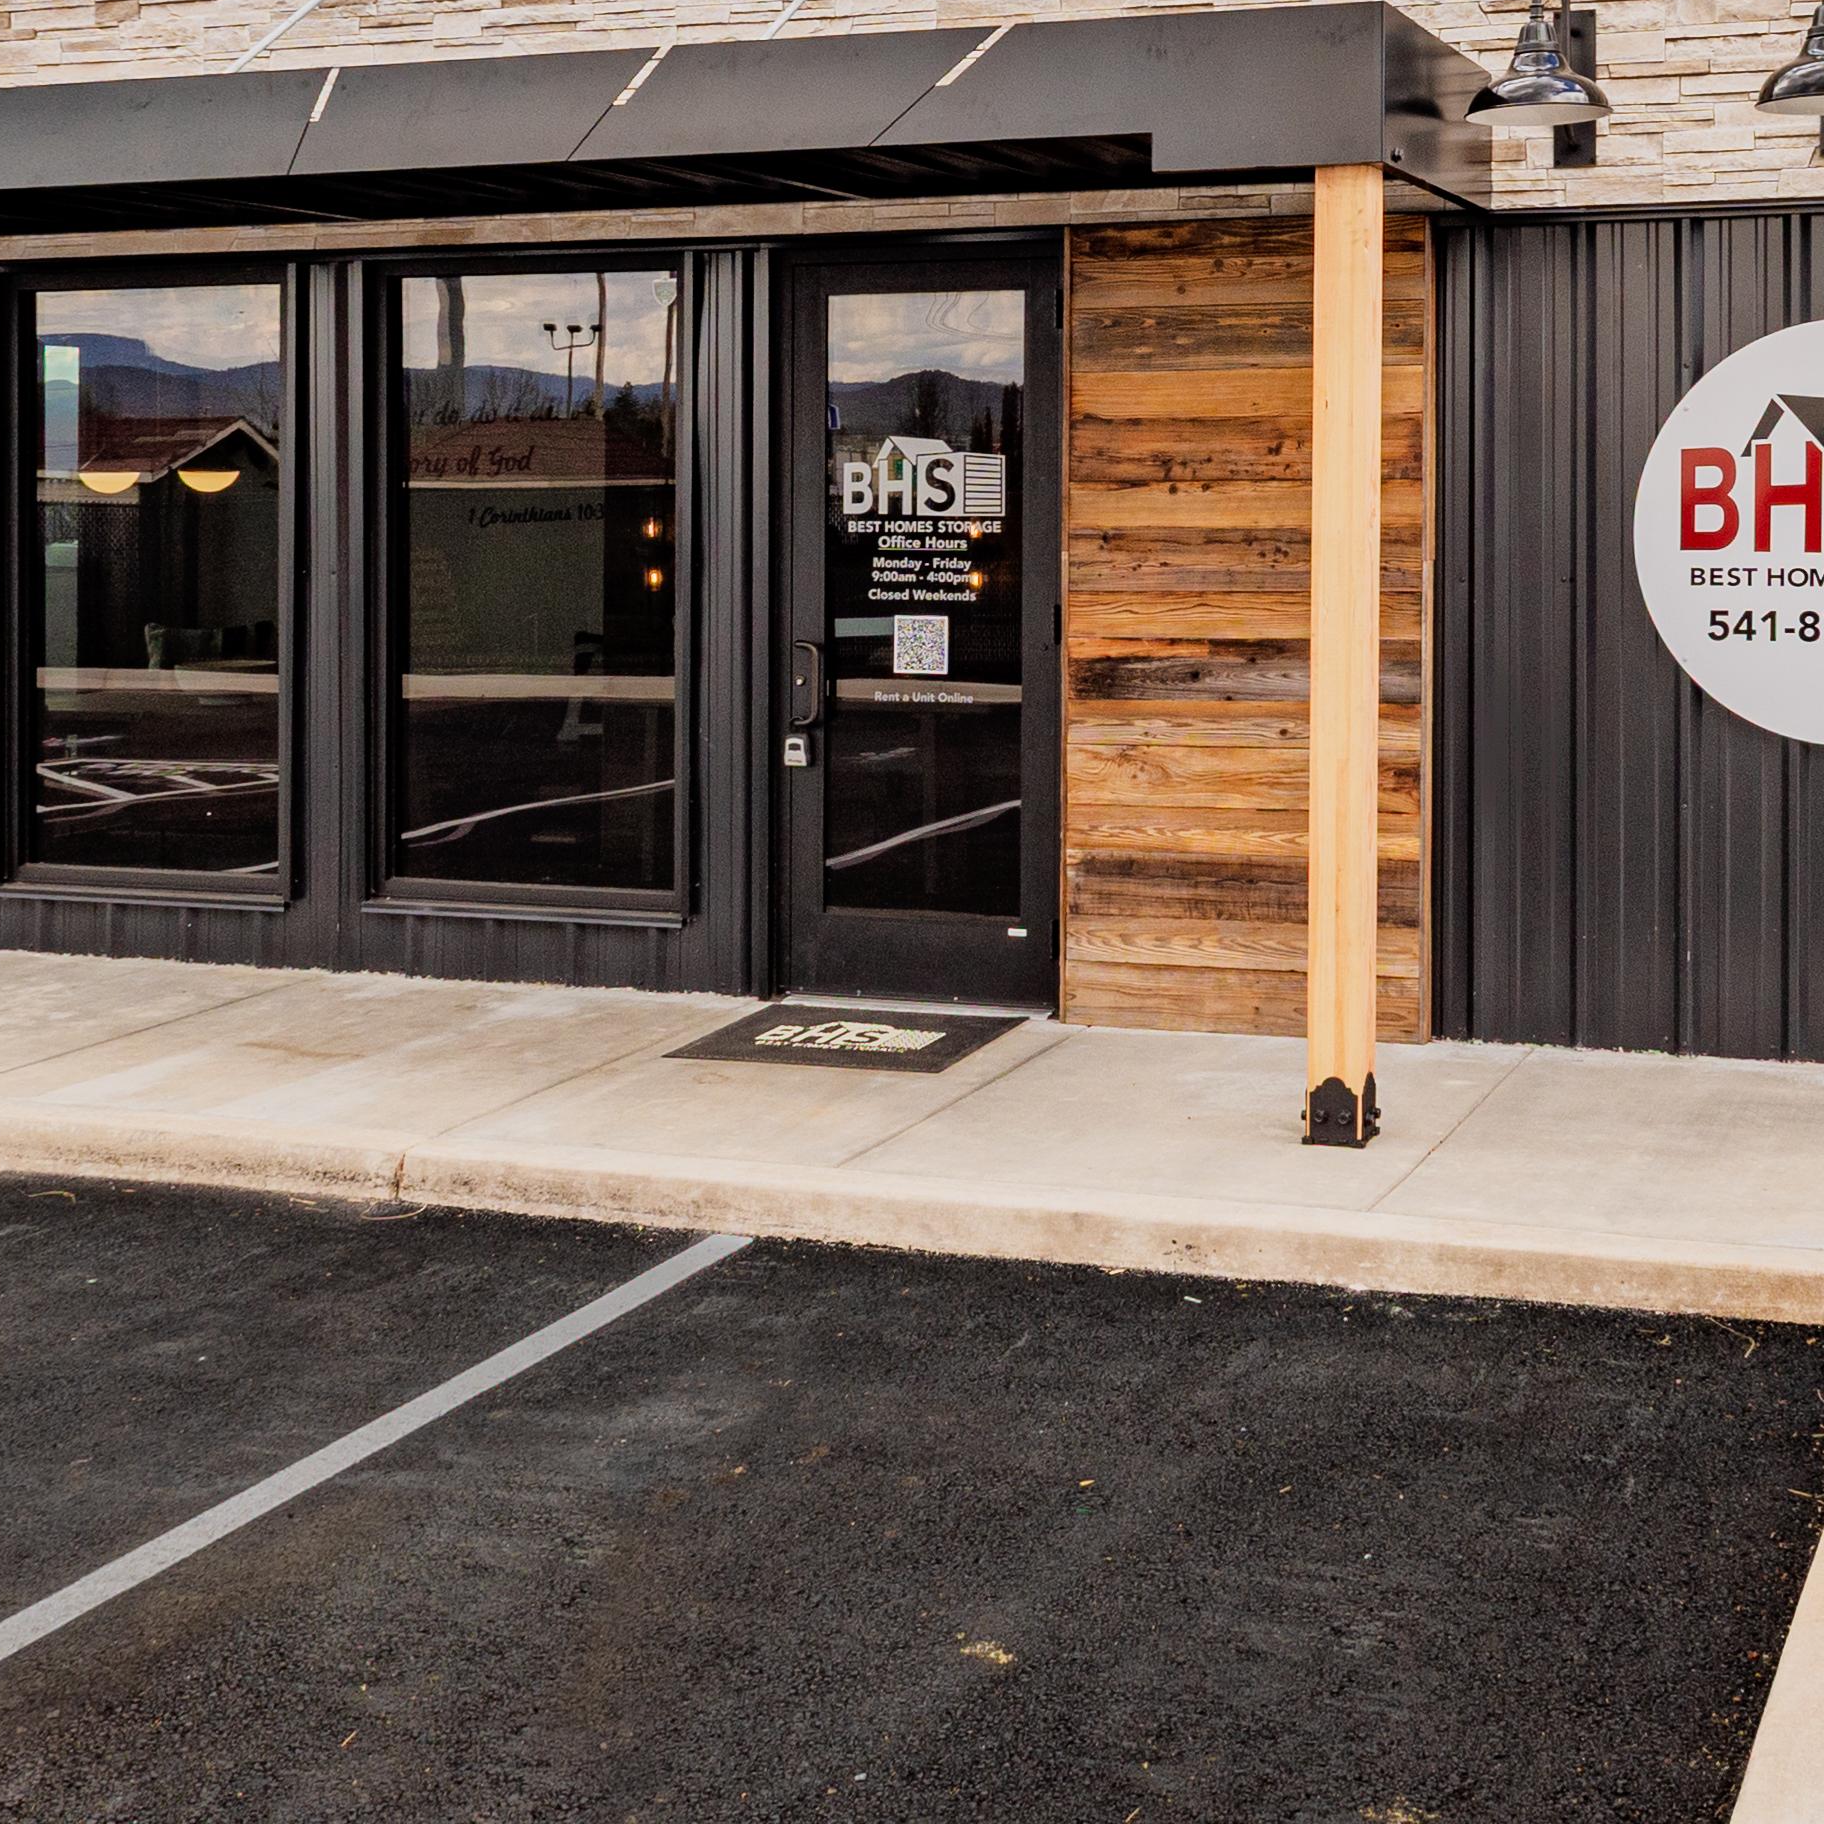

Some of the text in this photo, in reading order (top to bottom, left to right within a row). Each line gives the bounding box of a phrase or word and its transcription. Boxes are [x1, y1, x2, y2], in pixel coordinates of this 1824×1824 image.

[843, 457, 956, 516] BHS
[848, 521, 1002, 534] BEST HOMES STORAGE
[878, 536, 967, 549] Office Hours
[873, 557, 922, 571] Monday
[933, 558, 971, 572] Friday
[872, 571, 917, 583] 9:00am
[926, 572, 975, 585] 4:00pm
[1690, 567, 1758, 587] BEST
[868, 588, 977, 602] Closed Weekends
[874, 691, 974, 704] Rent a Unit Online
